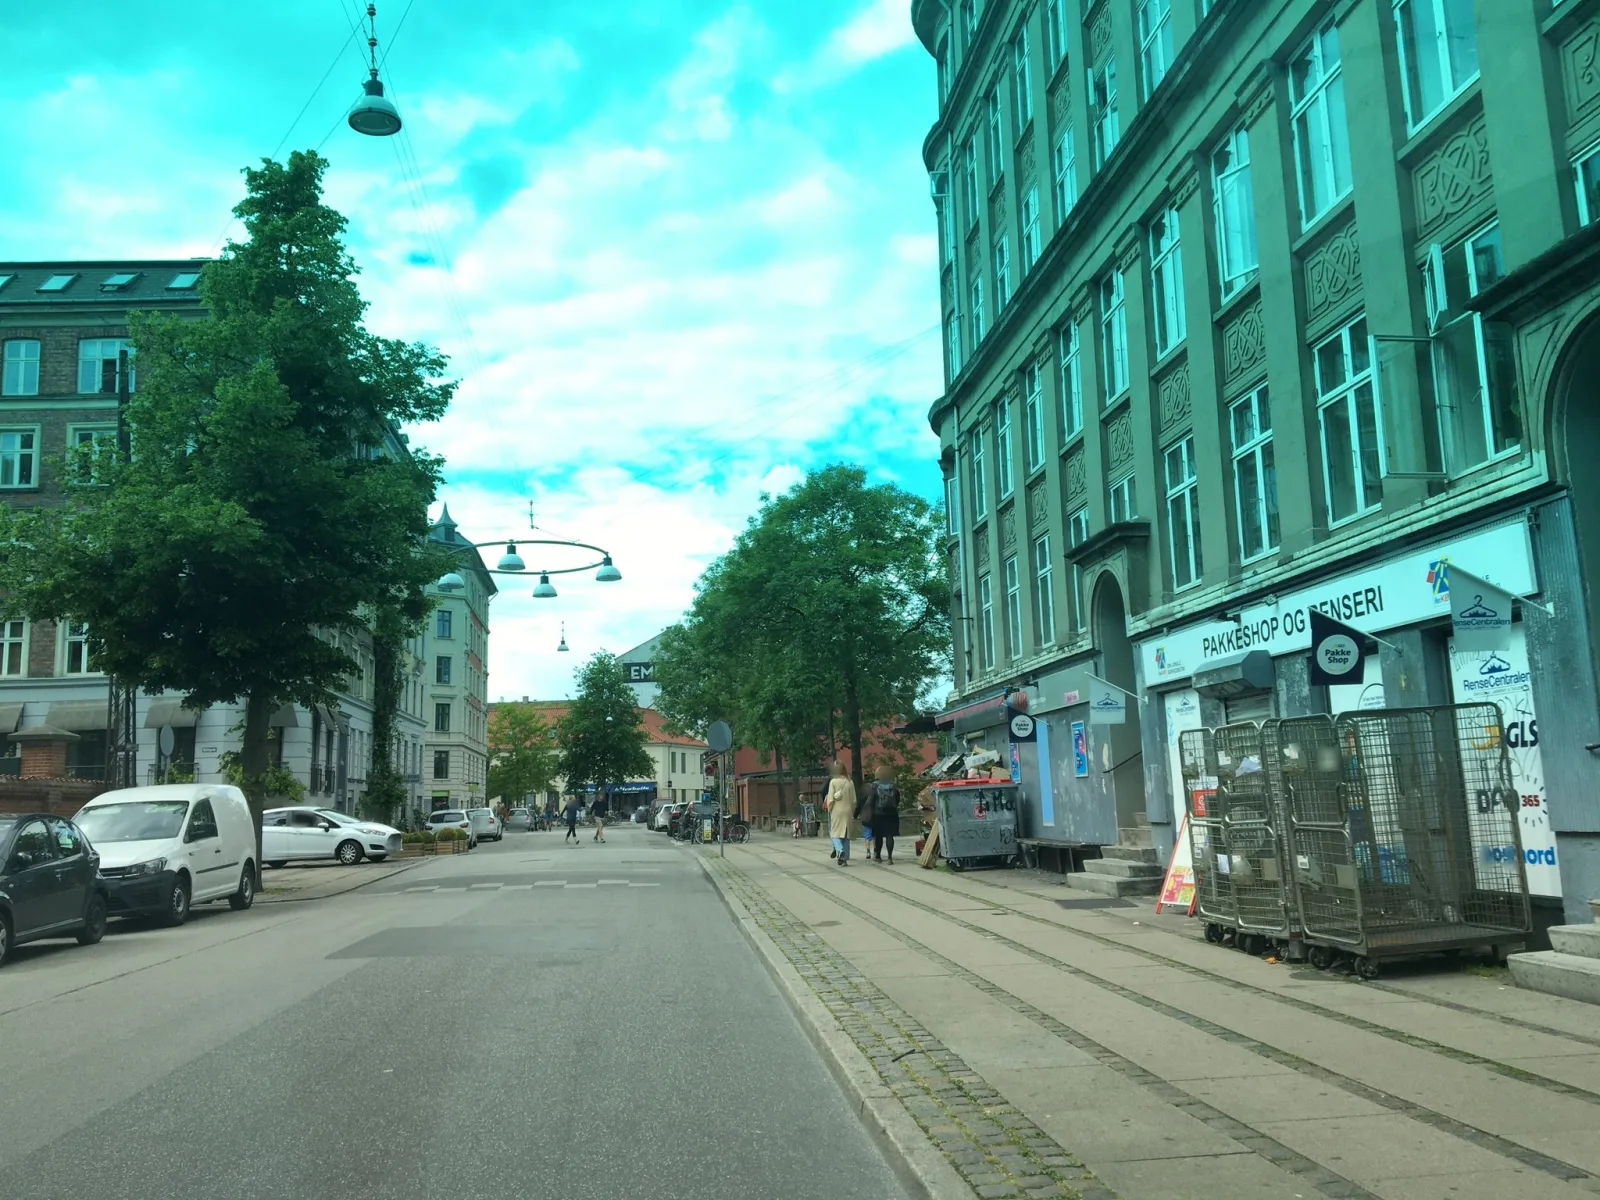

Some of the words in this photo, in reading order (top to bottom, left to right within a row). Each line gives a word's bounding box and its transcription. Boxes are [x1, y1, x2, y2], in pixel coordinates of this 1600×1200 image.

[1203, 616, 1279, 658] PAKKESHOP
[1283, 610, 1306, 635] OG
[1325, 649, 1351, 657] Pakke
[1328, 656, 1349, 665] Shop
[1506, 720, 1539, 748] GLS
[1521, 795, 1540, 807] 365
